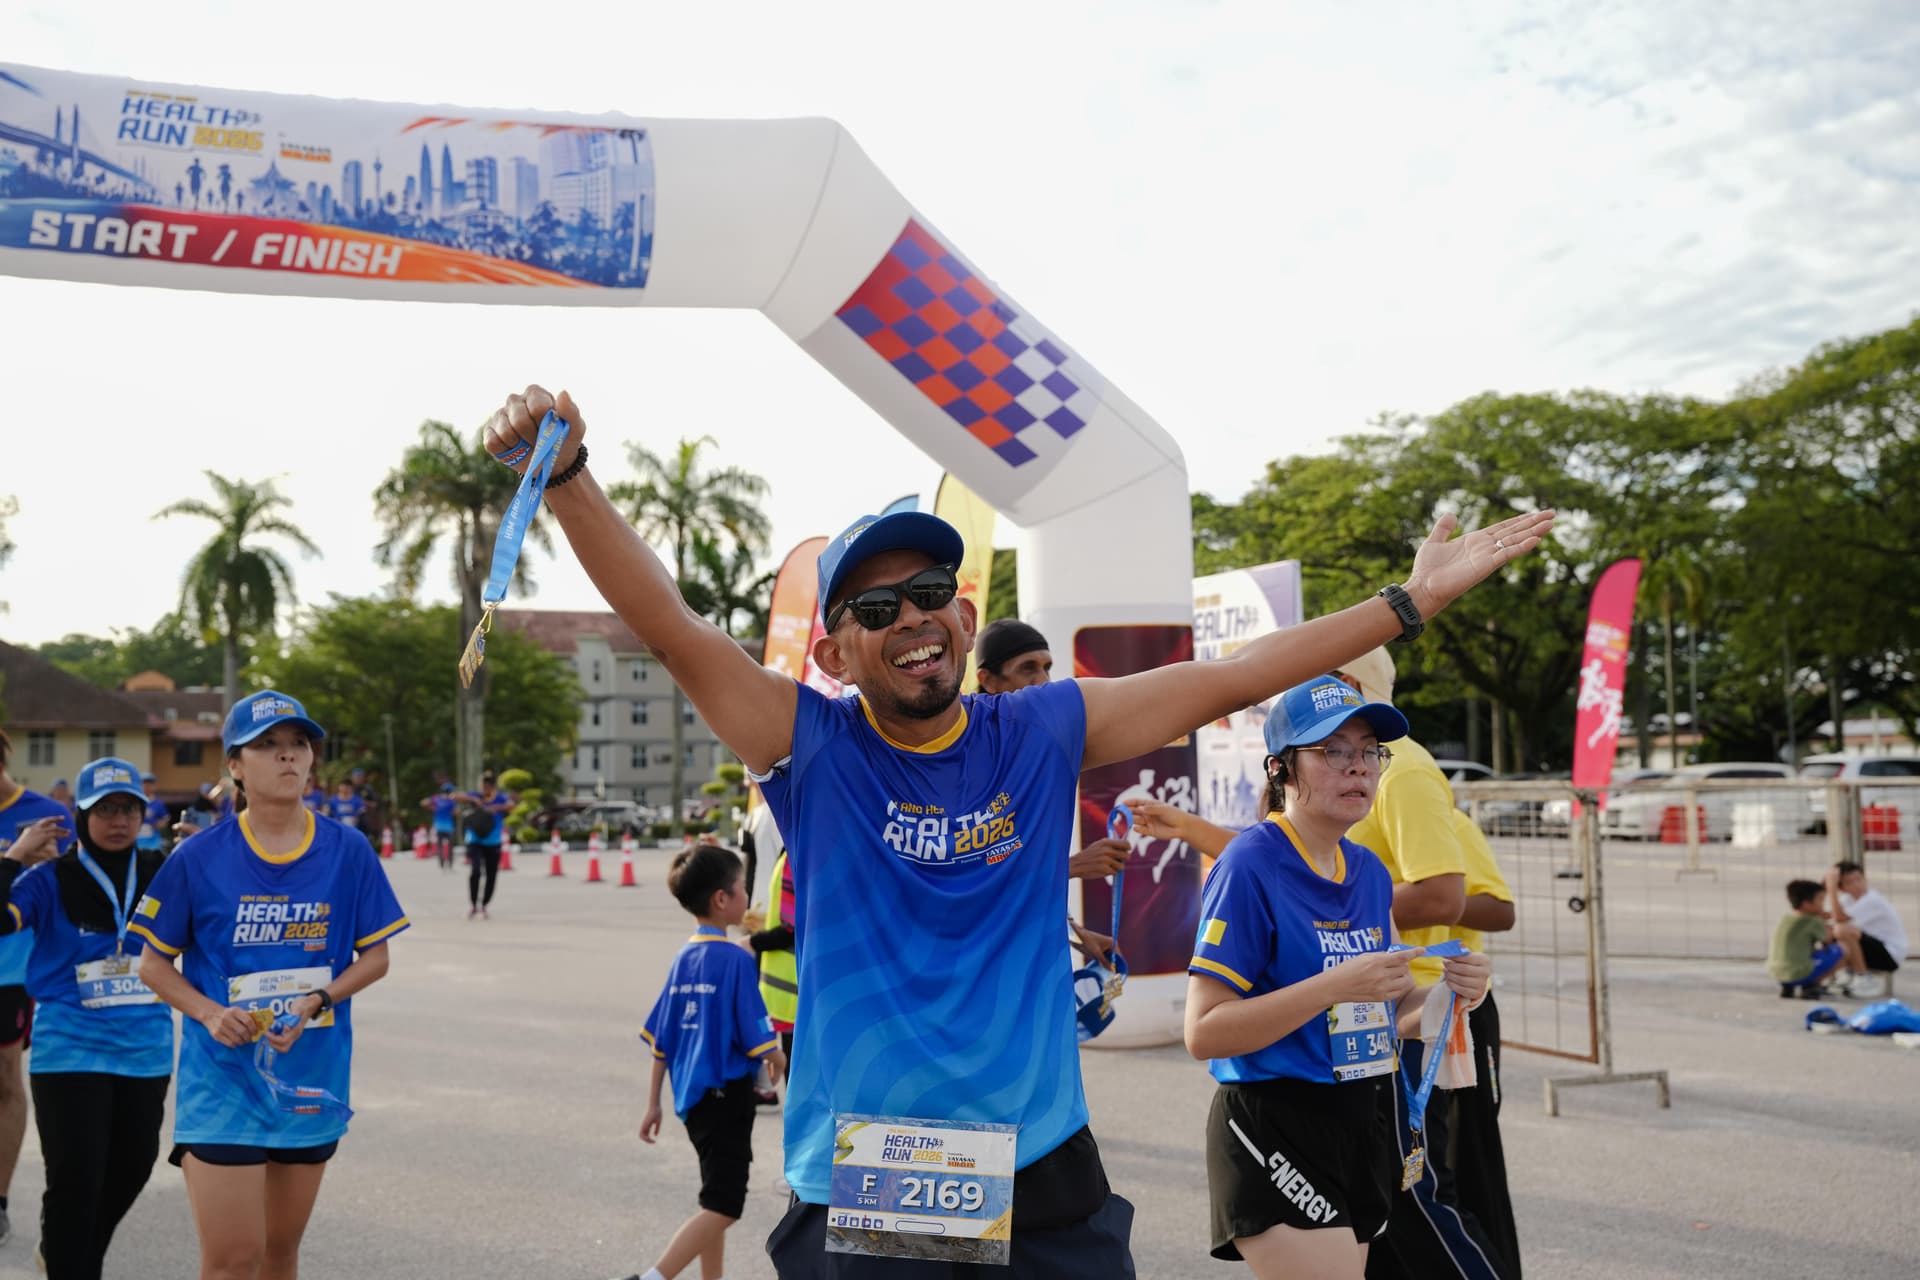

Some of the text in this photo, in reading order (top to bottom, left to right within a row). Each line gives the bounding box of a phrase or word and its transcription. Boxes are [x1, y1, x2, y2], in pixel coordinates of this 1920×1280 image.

[121, 97, 239, 126] HEALTH
[117, 118, 264, 151] RUN 2026
[29, 209, 198, 258] START
[250, 232, 403, 276] FINISH
[1193, 607, 1248, 642] EALTH
[882, 811, 1017, 861] RUN 2026
[236, 902, 320, 923] HEALTH
[232, 921, 330, 944] RUN 2026
[1316, 927, 1377, 954] HEALTH
[1346, 1036, 1358, 1052] H
[882, 1147, 943, 1161] RUN 2026
[884, 1134, 936, 1149] HEALTH
[862, 1174, 985, 1212] F 2169
[864, 1197, 877, 1206] KM
